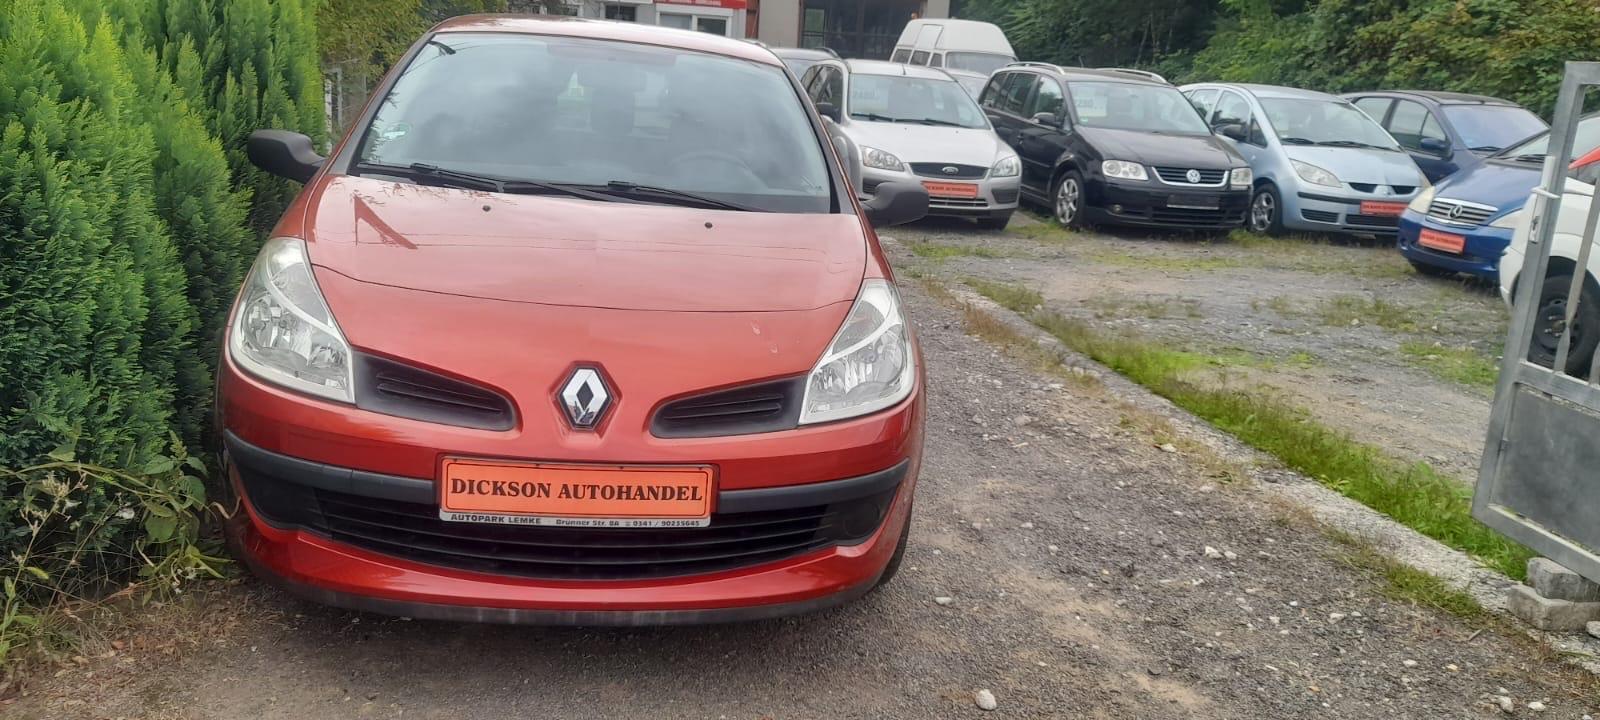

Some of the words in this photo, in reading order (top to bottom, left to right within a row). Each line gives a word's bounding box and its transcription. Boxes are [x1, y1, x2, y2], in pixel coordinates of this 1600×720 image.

[450, 478, 552, 498] DICKSON
[557, 483, 703, 501] AUTOHANDEL
[450, 513, 505, 523] AUTOPARK
[508, 516, 542, 525] LEMKE
